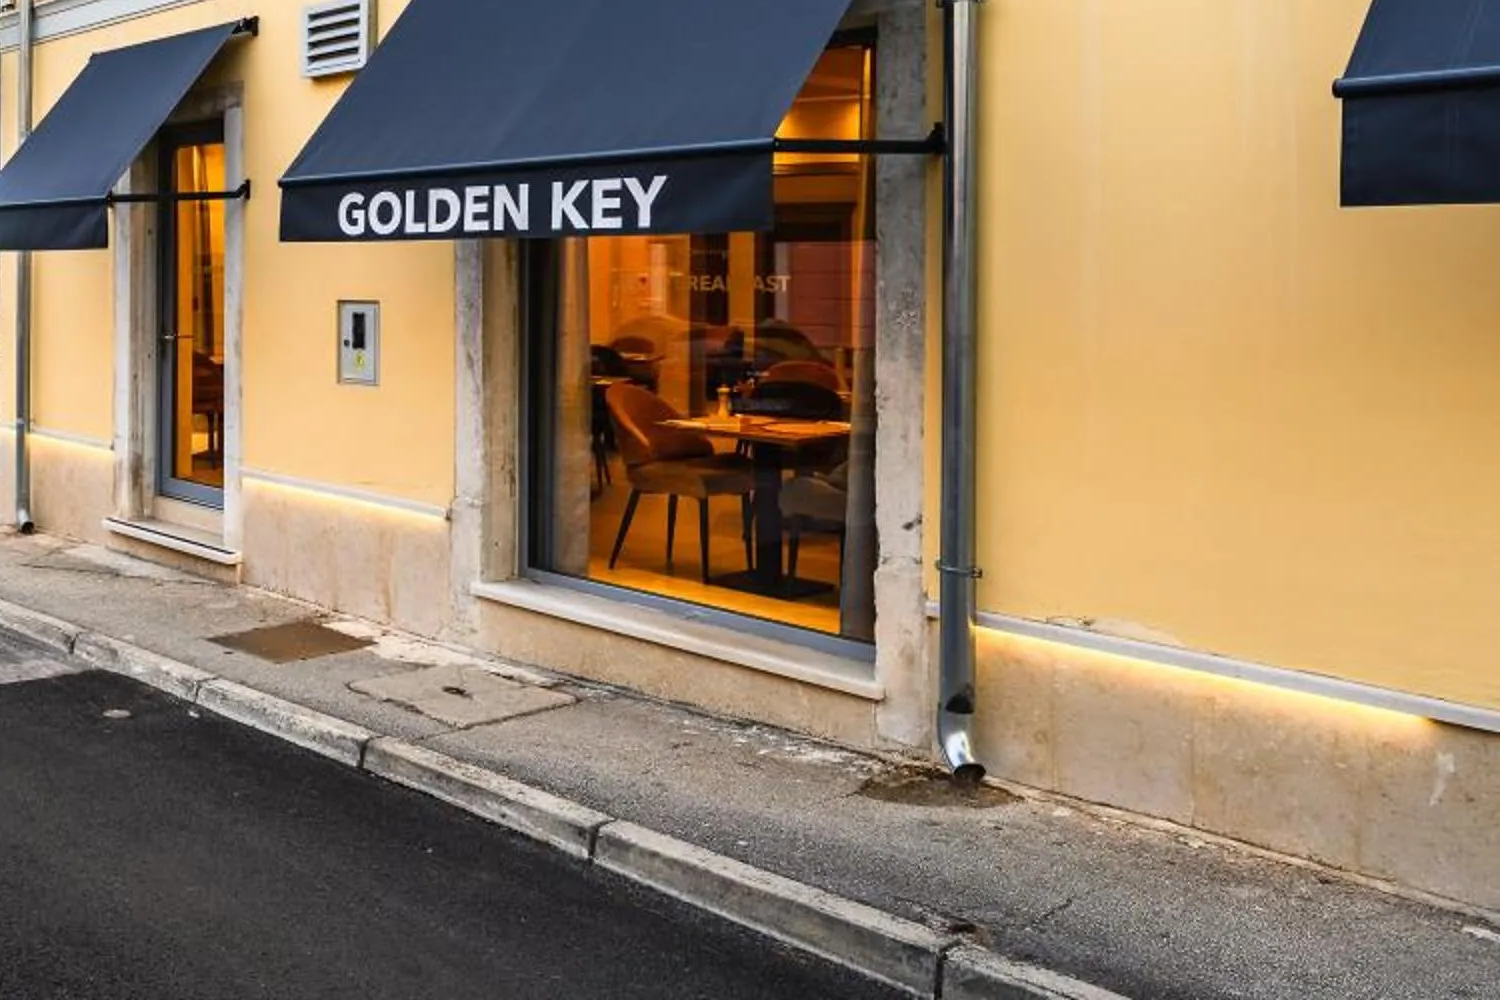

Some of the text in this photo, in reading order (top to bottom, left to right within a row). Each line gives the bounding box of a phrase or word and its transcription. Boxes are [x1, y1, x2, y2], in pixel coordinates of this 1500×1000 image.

[338, 175, 667, 236] GOLDEN KEY
[676, 274, 792, 292] REAAST
